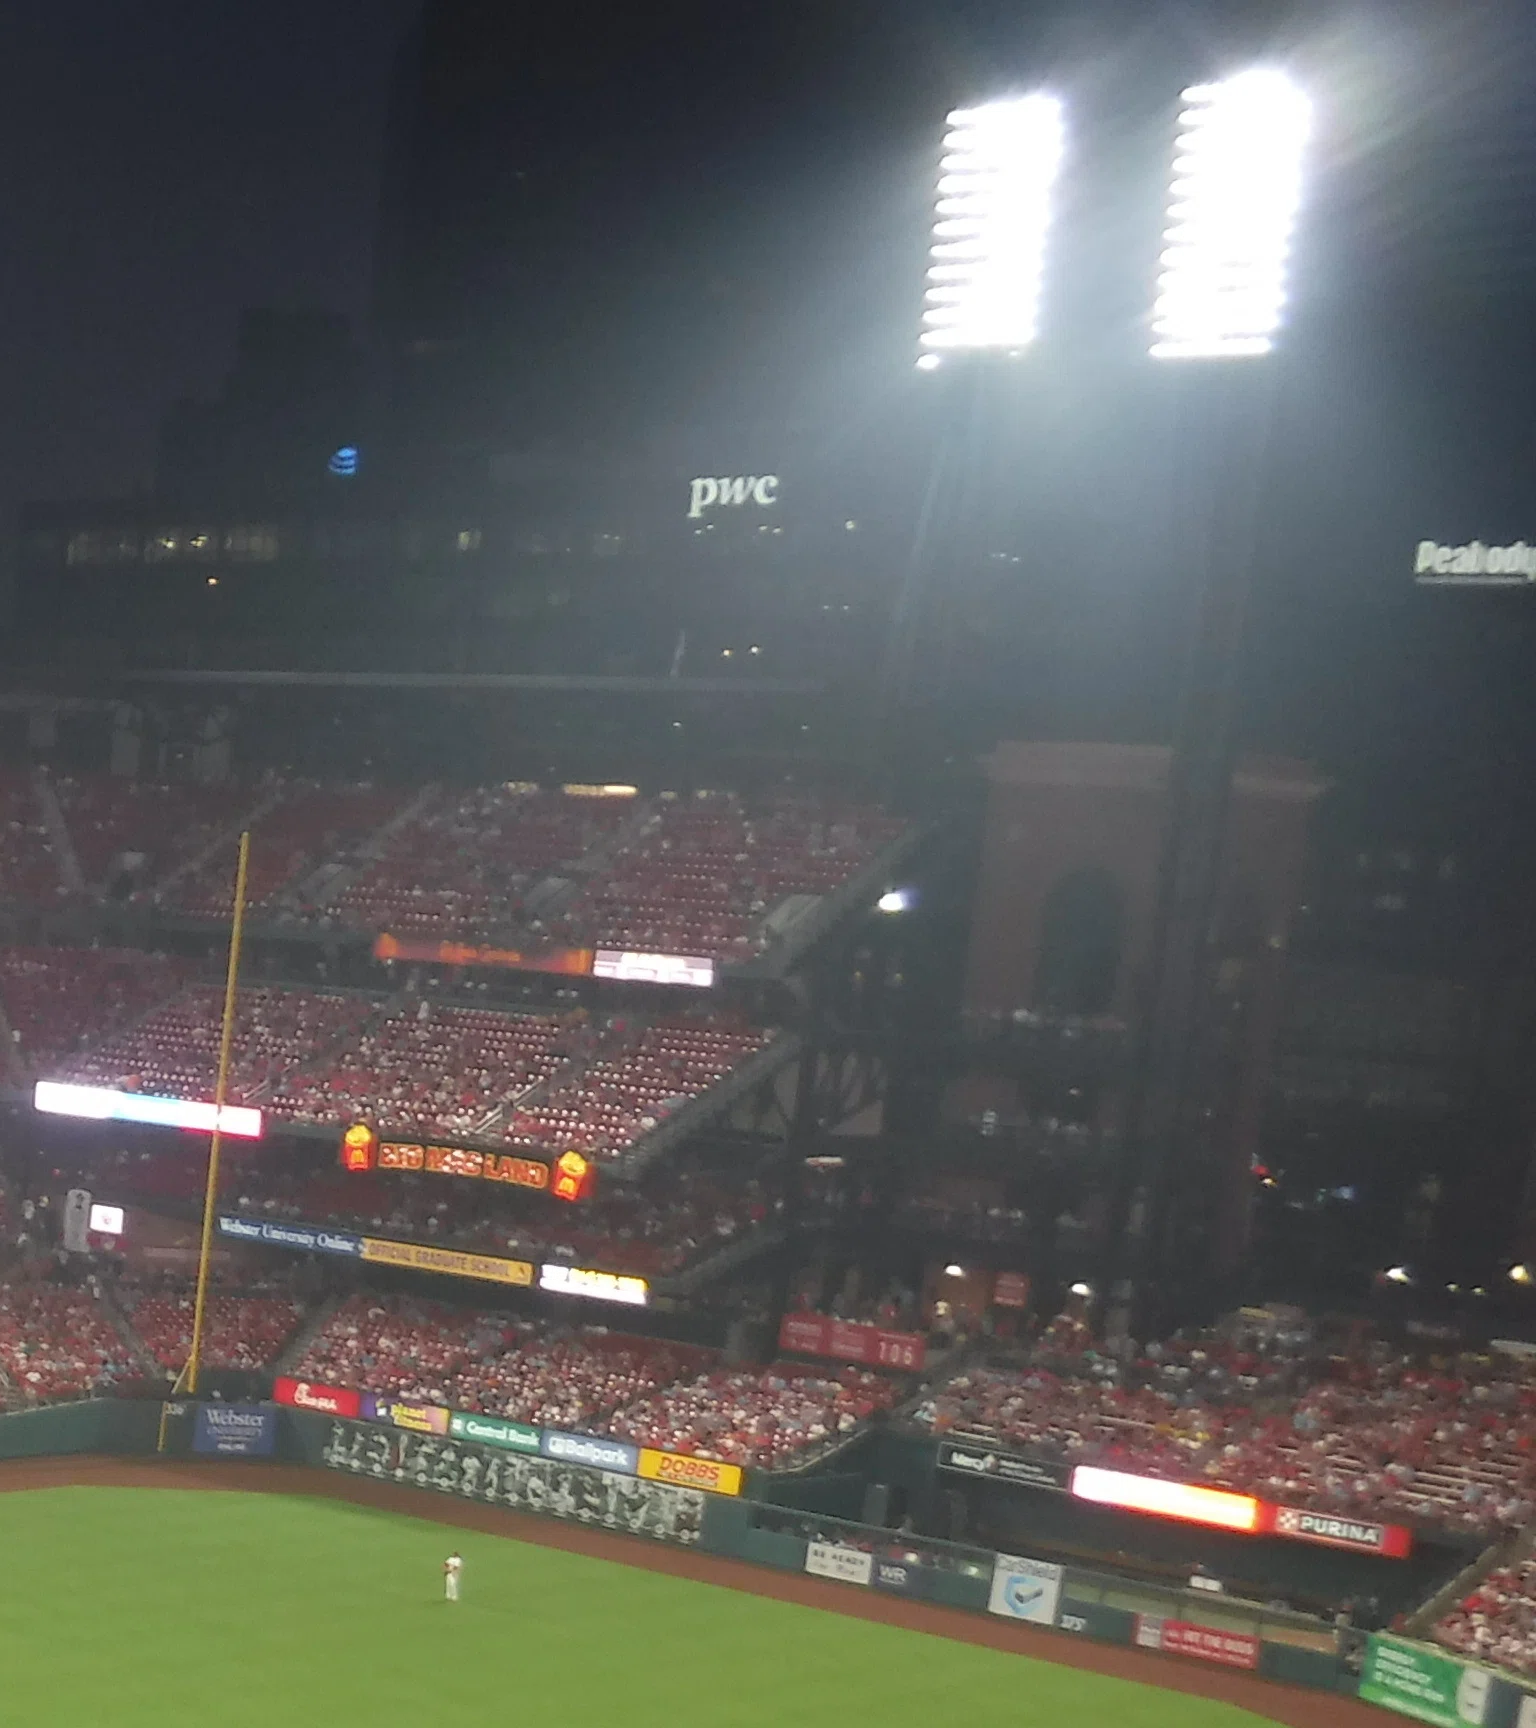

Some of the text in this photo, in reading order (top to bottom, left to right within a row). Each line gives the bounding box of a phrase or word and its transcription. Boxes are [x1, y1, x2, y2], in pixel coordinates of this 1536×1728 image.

[688, 475, 778, 518] pwc
[483, 1152, 549, 1189] LAND
[206, 1408, 265, 1427] Webster
[466, 1420, 540, 1446] Central Bank
[567, 1438, 628, 1466] Ballpark
[659, 1456, 720, 1481] DOBBS
[1300, 1516, 1378, 1542] PURINA
